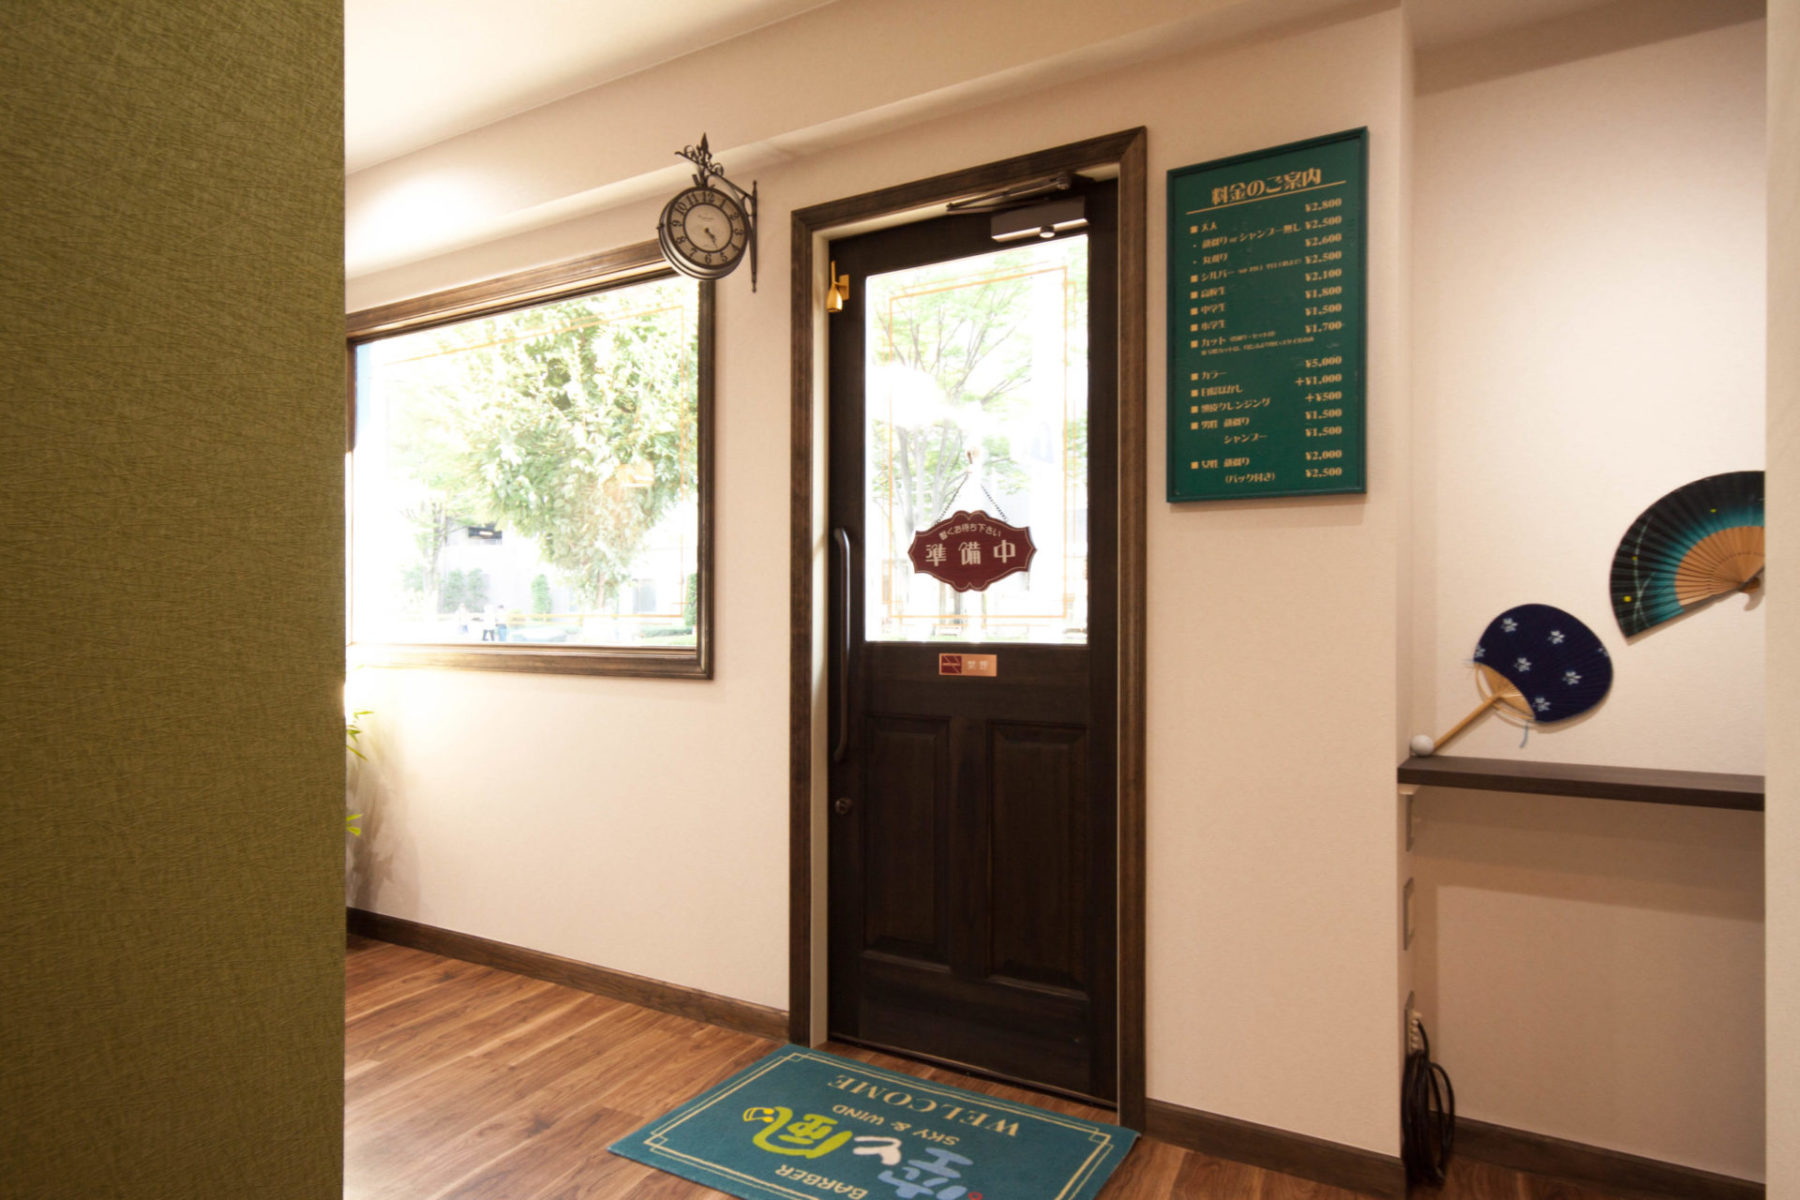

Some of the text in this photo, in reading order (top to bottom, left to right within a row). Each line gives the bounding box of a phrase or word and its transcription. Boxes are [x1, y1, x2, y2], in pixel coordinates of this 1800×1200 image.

[1211, 167, 1322, 206] 料金のご案内
[1201, 221, 1218, 233] 大人
[1201, 269, 1235, 282] シルバー
[1201, 336, 1226, 348] カット
[1201, 370, 1227, 380] カラー
[1224, 432, 1268, 444] シャンプー
[925, 539, 1017, 567] 準備中
[827, 1074, 1020, 1137] WELCOME
[832, 1104, 960, 1146] SKY & WIND
[775, 1164, 868, 1200] BARBER
